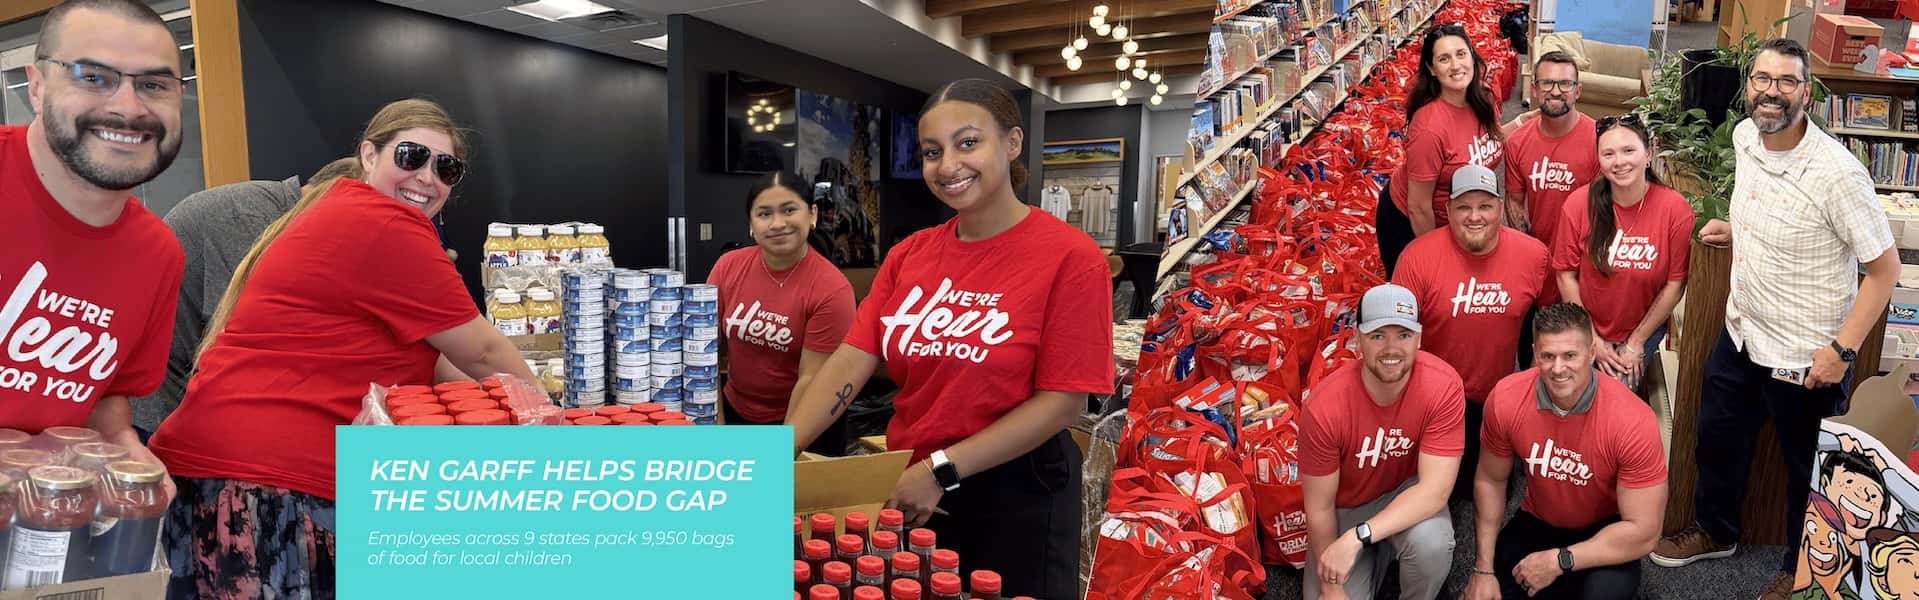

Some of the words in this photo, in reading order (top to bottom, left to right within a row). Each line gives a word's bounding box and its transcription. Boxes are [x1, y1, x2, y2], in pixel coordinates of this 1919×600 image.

[1613, 260, 1631, 269] FOR
[1633, 261, 1652, 270] YOU
[940, 289, 1004, 308] WE'RE
[1450, 276, 1511, 318] Hear
[37, 288, 115, 329] WE'RE
[757, 309, 790, 326] WE'RE
[1469, 306, 1486, 314] FOR
[1488, 306, 1506, 314] YOU
[726, 300, 794, 345] Here
[880, 277, 1014, 362] Hear
[744, 335, 766, 347] FOR
[767, 341, 790, 353] YOU
[907, 341, 944, 357] FOR
[944, 341, 990, 364] YOU
[42, 376, 95, 403] YOU
[1389, 450, 1409, 458] YOU
[1525, 438, 1594, 480] Hear
[1553, 446, 1582, 462] WE'RE
[1548, 471, 1568, 481] FOR
[1568, 475, 1588, 486] YOU
